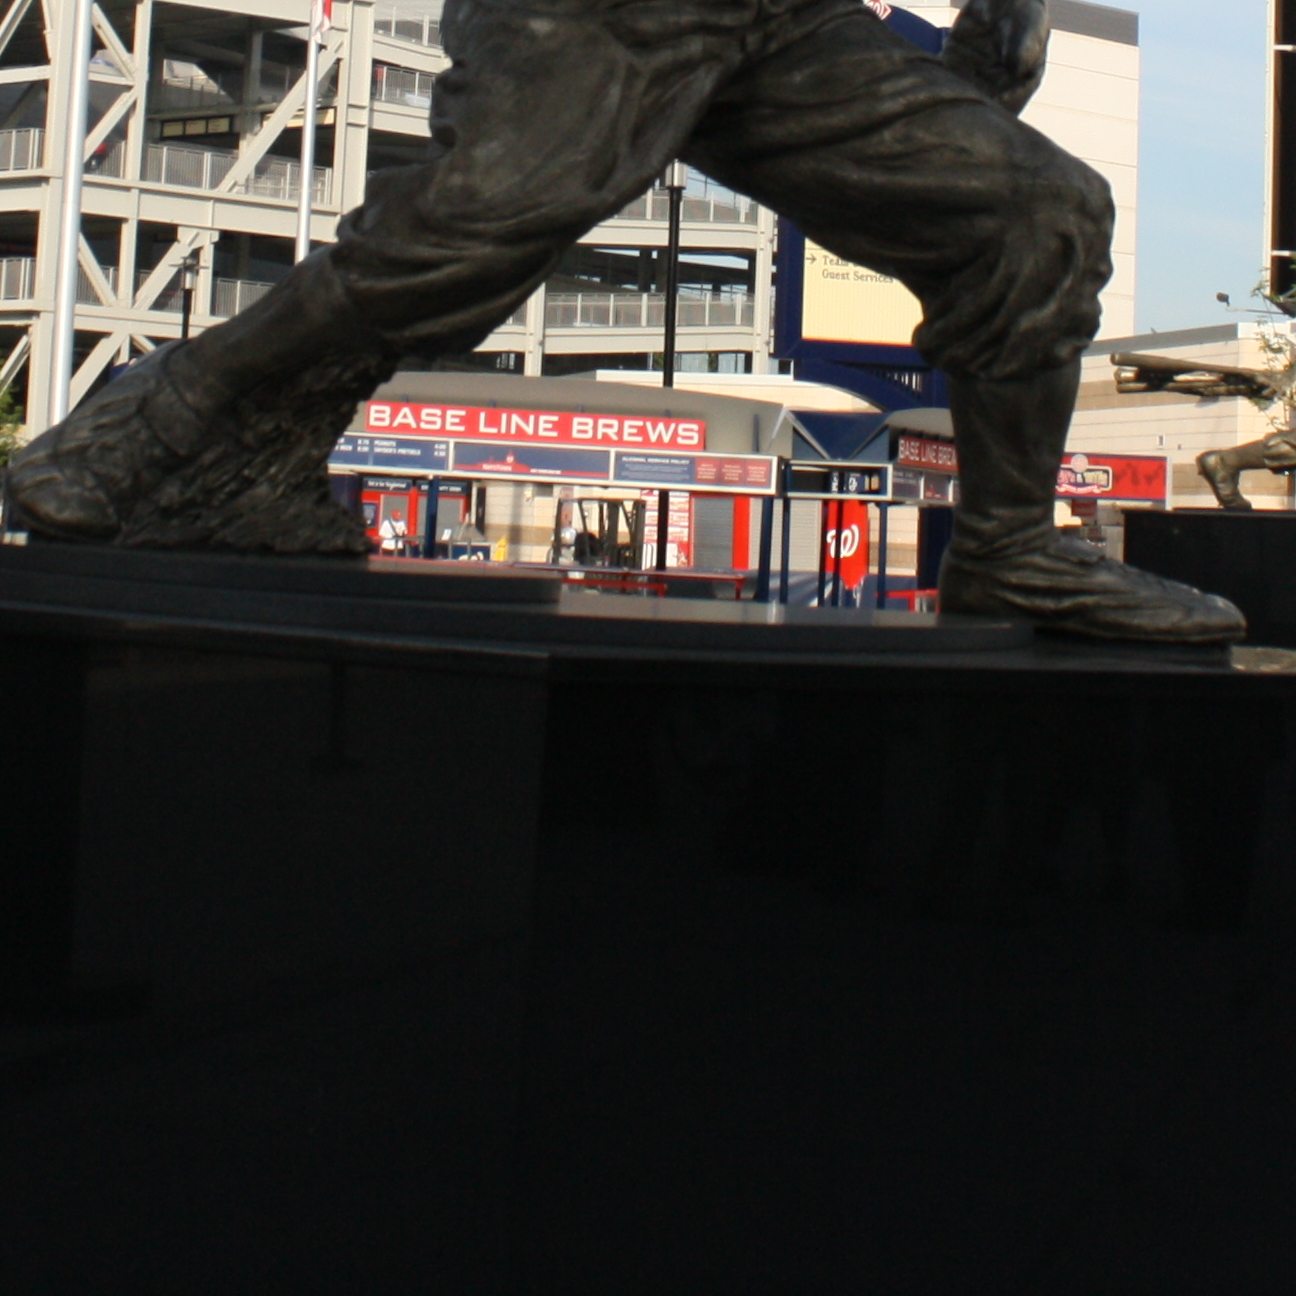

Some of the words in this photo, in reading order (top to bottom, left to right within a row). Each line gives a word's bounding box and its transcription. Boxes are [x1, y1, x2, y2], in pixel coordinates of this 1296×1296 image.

[822, 269, 851, 281] Guest
[368, 404, 467, 432] BASE
[478, 411, 560, 438] LINE
[570, 416, 701, 445] BREWS
[899, 439, 920, 461] BASE
[921, 442, 937, 464] LINE
